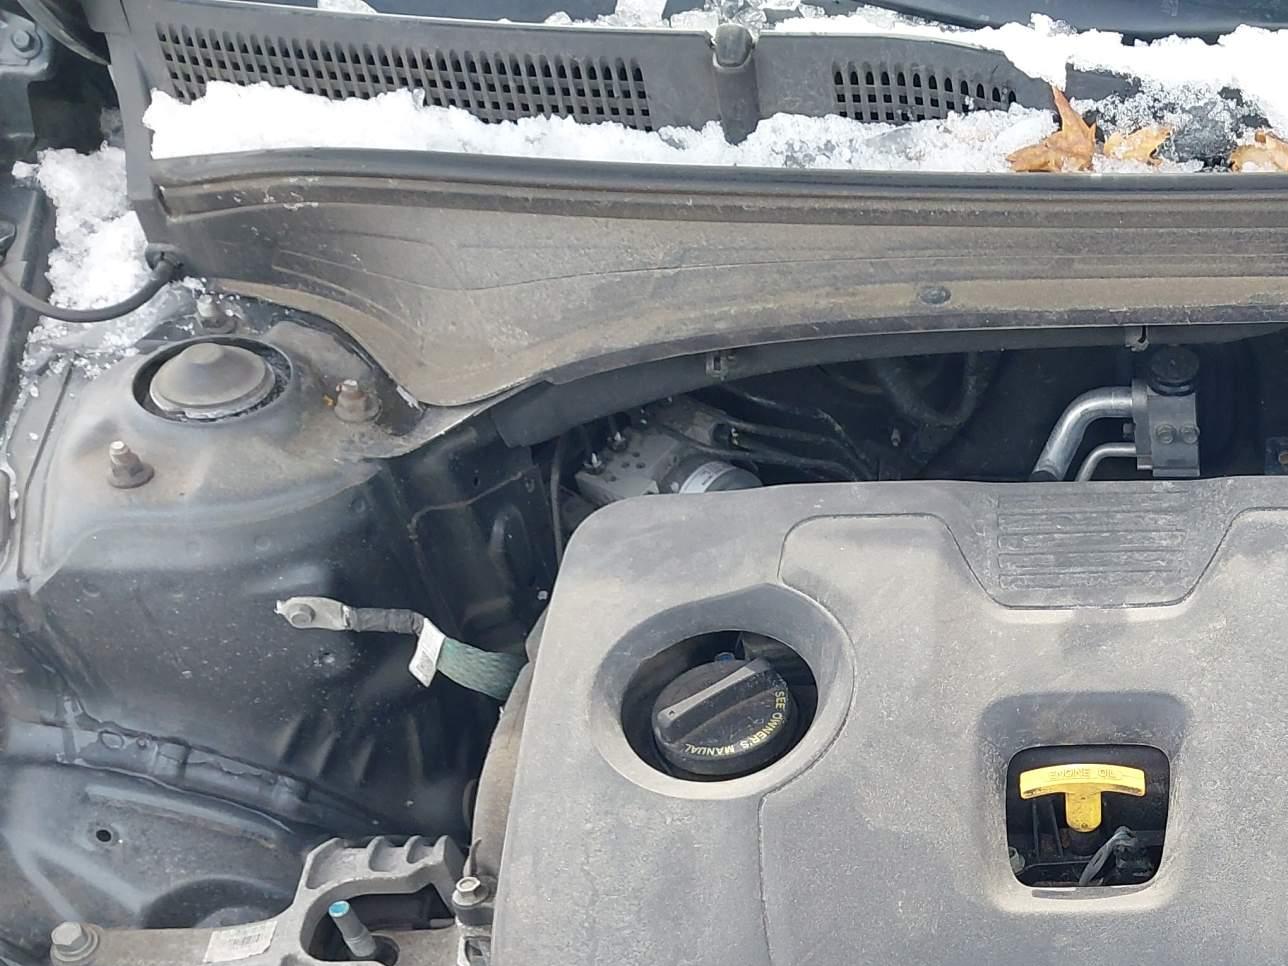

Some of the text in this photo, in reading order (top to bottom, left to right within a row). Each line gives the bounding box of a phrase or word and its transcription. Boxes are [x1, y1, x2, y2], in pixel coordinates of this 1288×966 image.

[684, 690, 787, 757] SEE OWNER'S MANUAL
[1097, 767, 1117, 779] OIL
